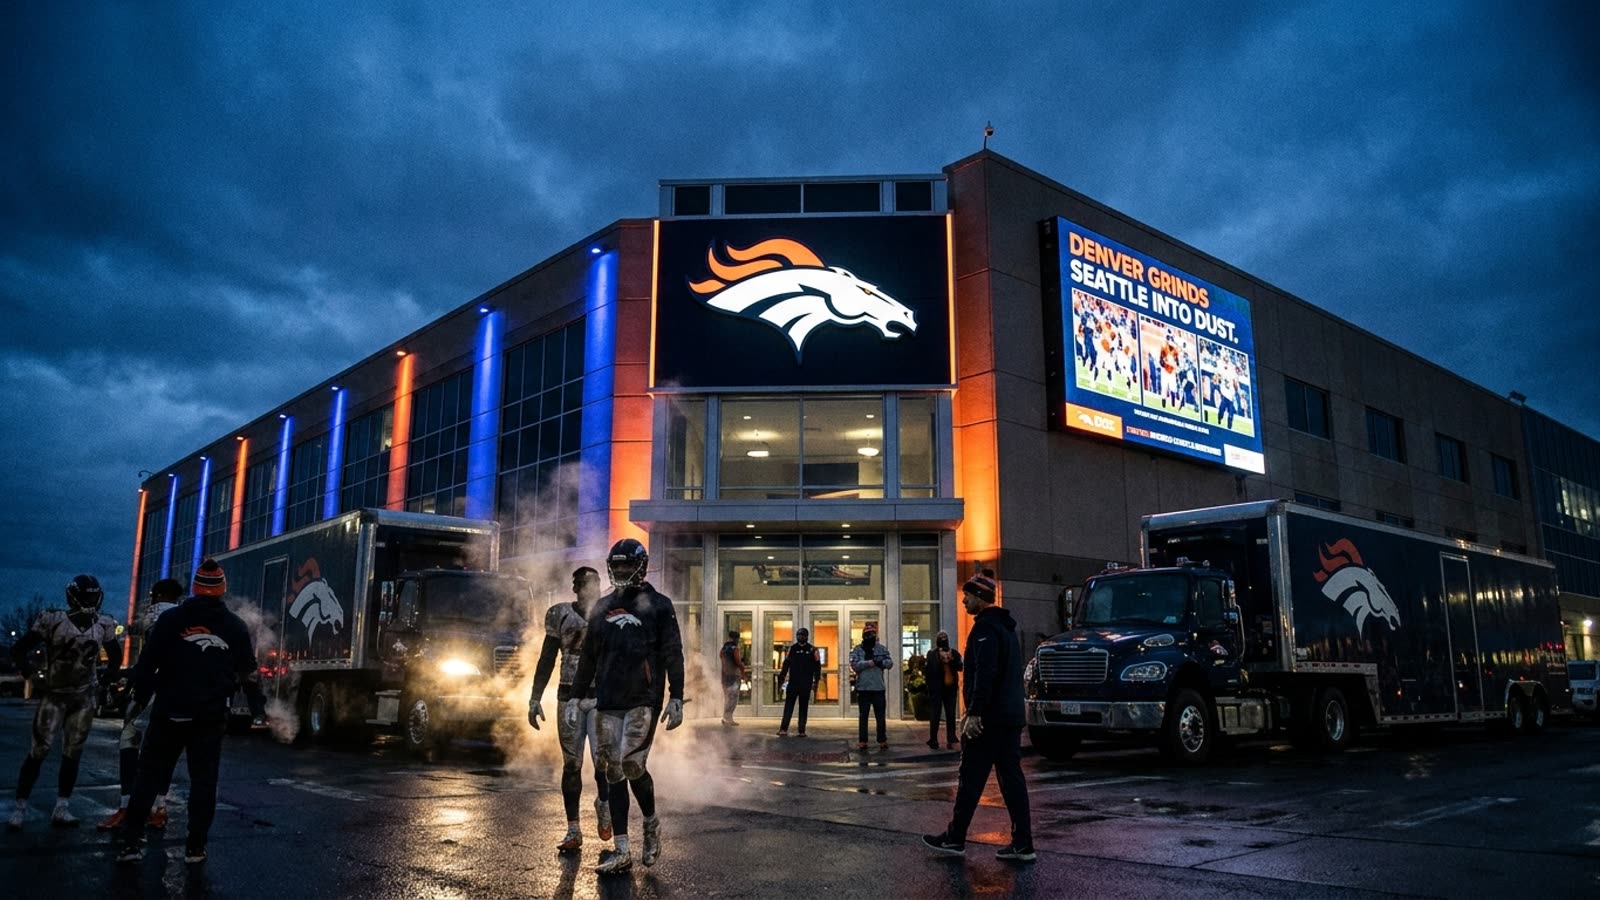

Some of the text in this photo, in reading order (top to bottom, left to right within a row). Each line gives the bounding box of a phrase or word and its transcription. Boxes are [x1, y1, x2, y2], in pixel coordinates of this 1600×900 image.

[1069, 232, 1209, 308] DENVER GRINDS
[1070, 259, 1239, 344] SEATTLE INTO DUST.
